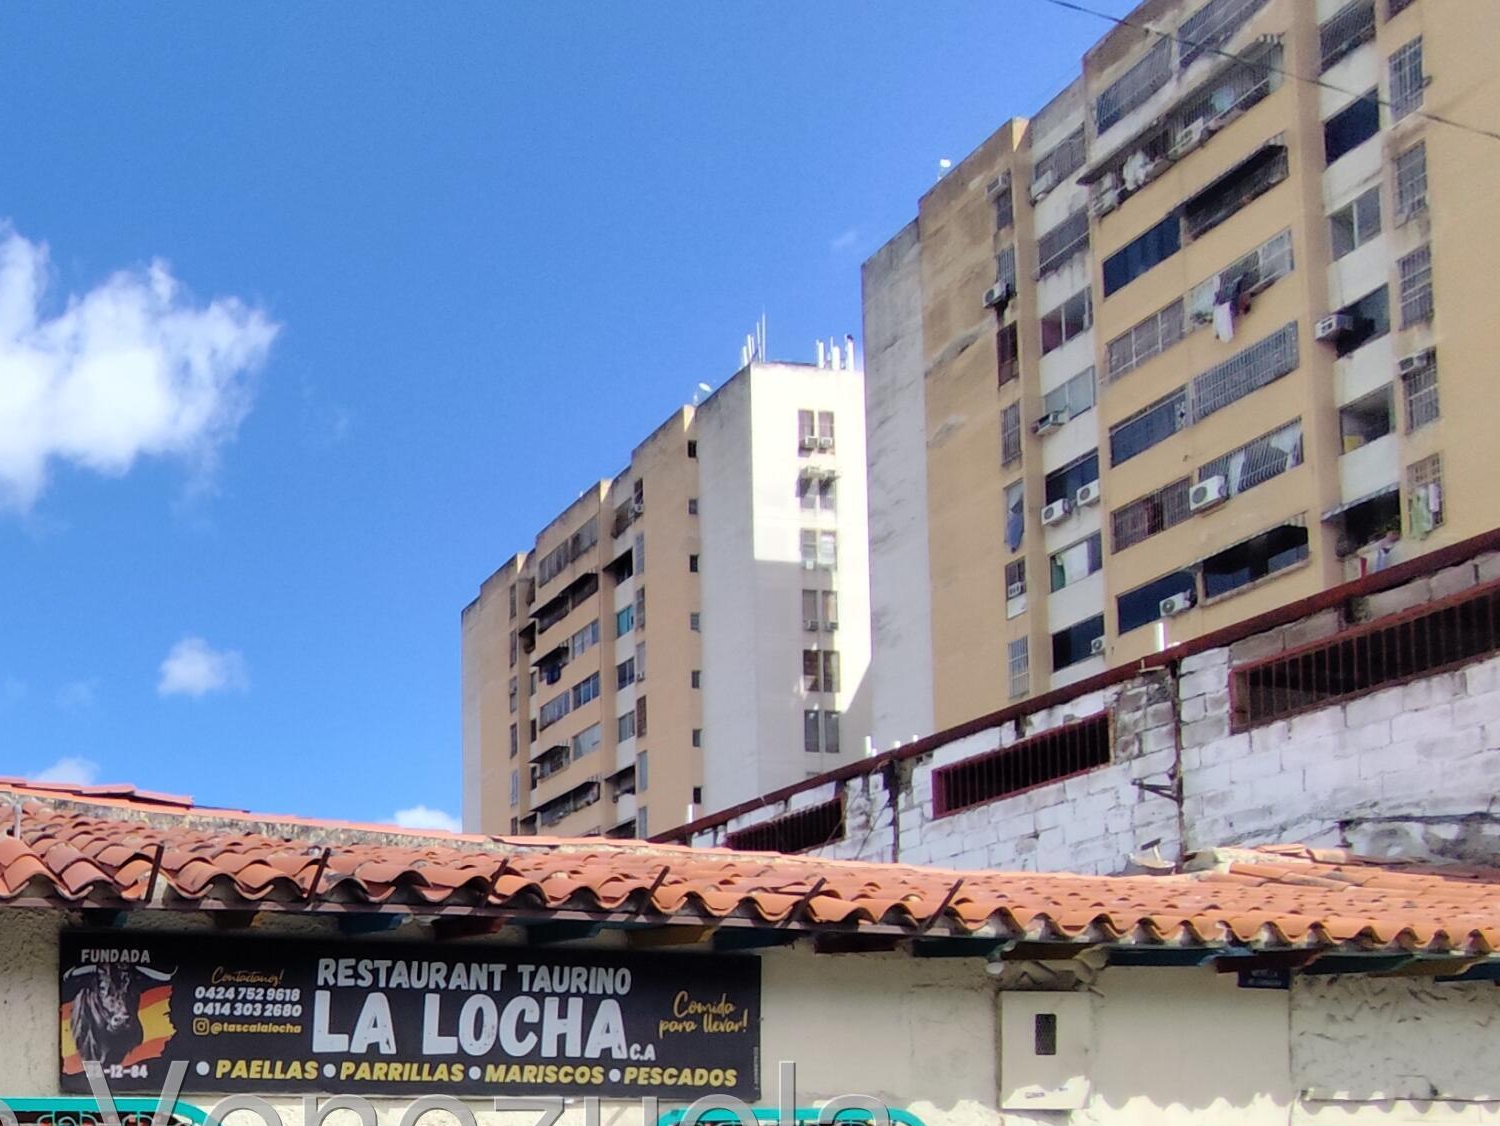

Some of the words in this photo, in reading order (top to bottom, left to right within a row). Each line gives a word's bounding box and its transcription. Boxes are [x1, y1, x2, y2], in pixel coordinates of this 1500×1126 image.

[80, 949, 151, 964] FUNDADA
[317, 958, 507, 992] RESTAURANT
[517, 964, 632, 996] TAURINO
[194, 986, 236, 1000] 0424
[237, 987, 265, 1001] 752
[266, 988, 301, 1002] 9618
[673, 990, 737, 1018] Comida
[193, 1002, 231, 1016] 0414
[233, 1002, 262, 1016] 303
[263, 1003, 302, 1017] 2680
[210, 1021, 302, 1035] @tascalalocha
[311, 989, 398, 1055] LA
[422, 992, 629, 1061] LOCHA
[659, 1017, 698, 1039] para
[703, 1008, 748, 1034] llevar!
[215, 1060, 319, 1081] PAELLAS
[339, 1061, 465, 1082] PARRILLAS
[484, 1065, 604, 1085] MARISCOS
[623, 1068, 738, 1087] PESCADOS
